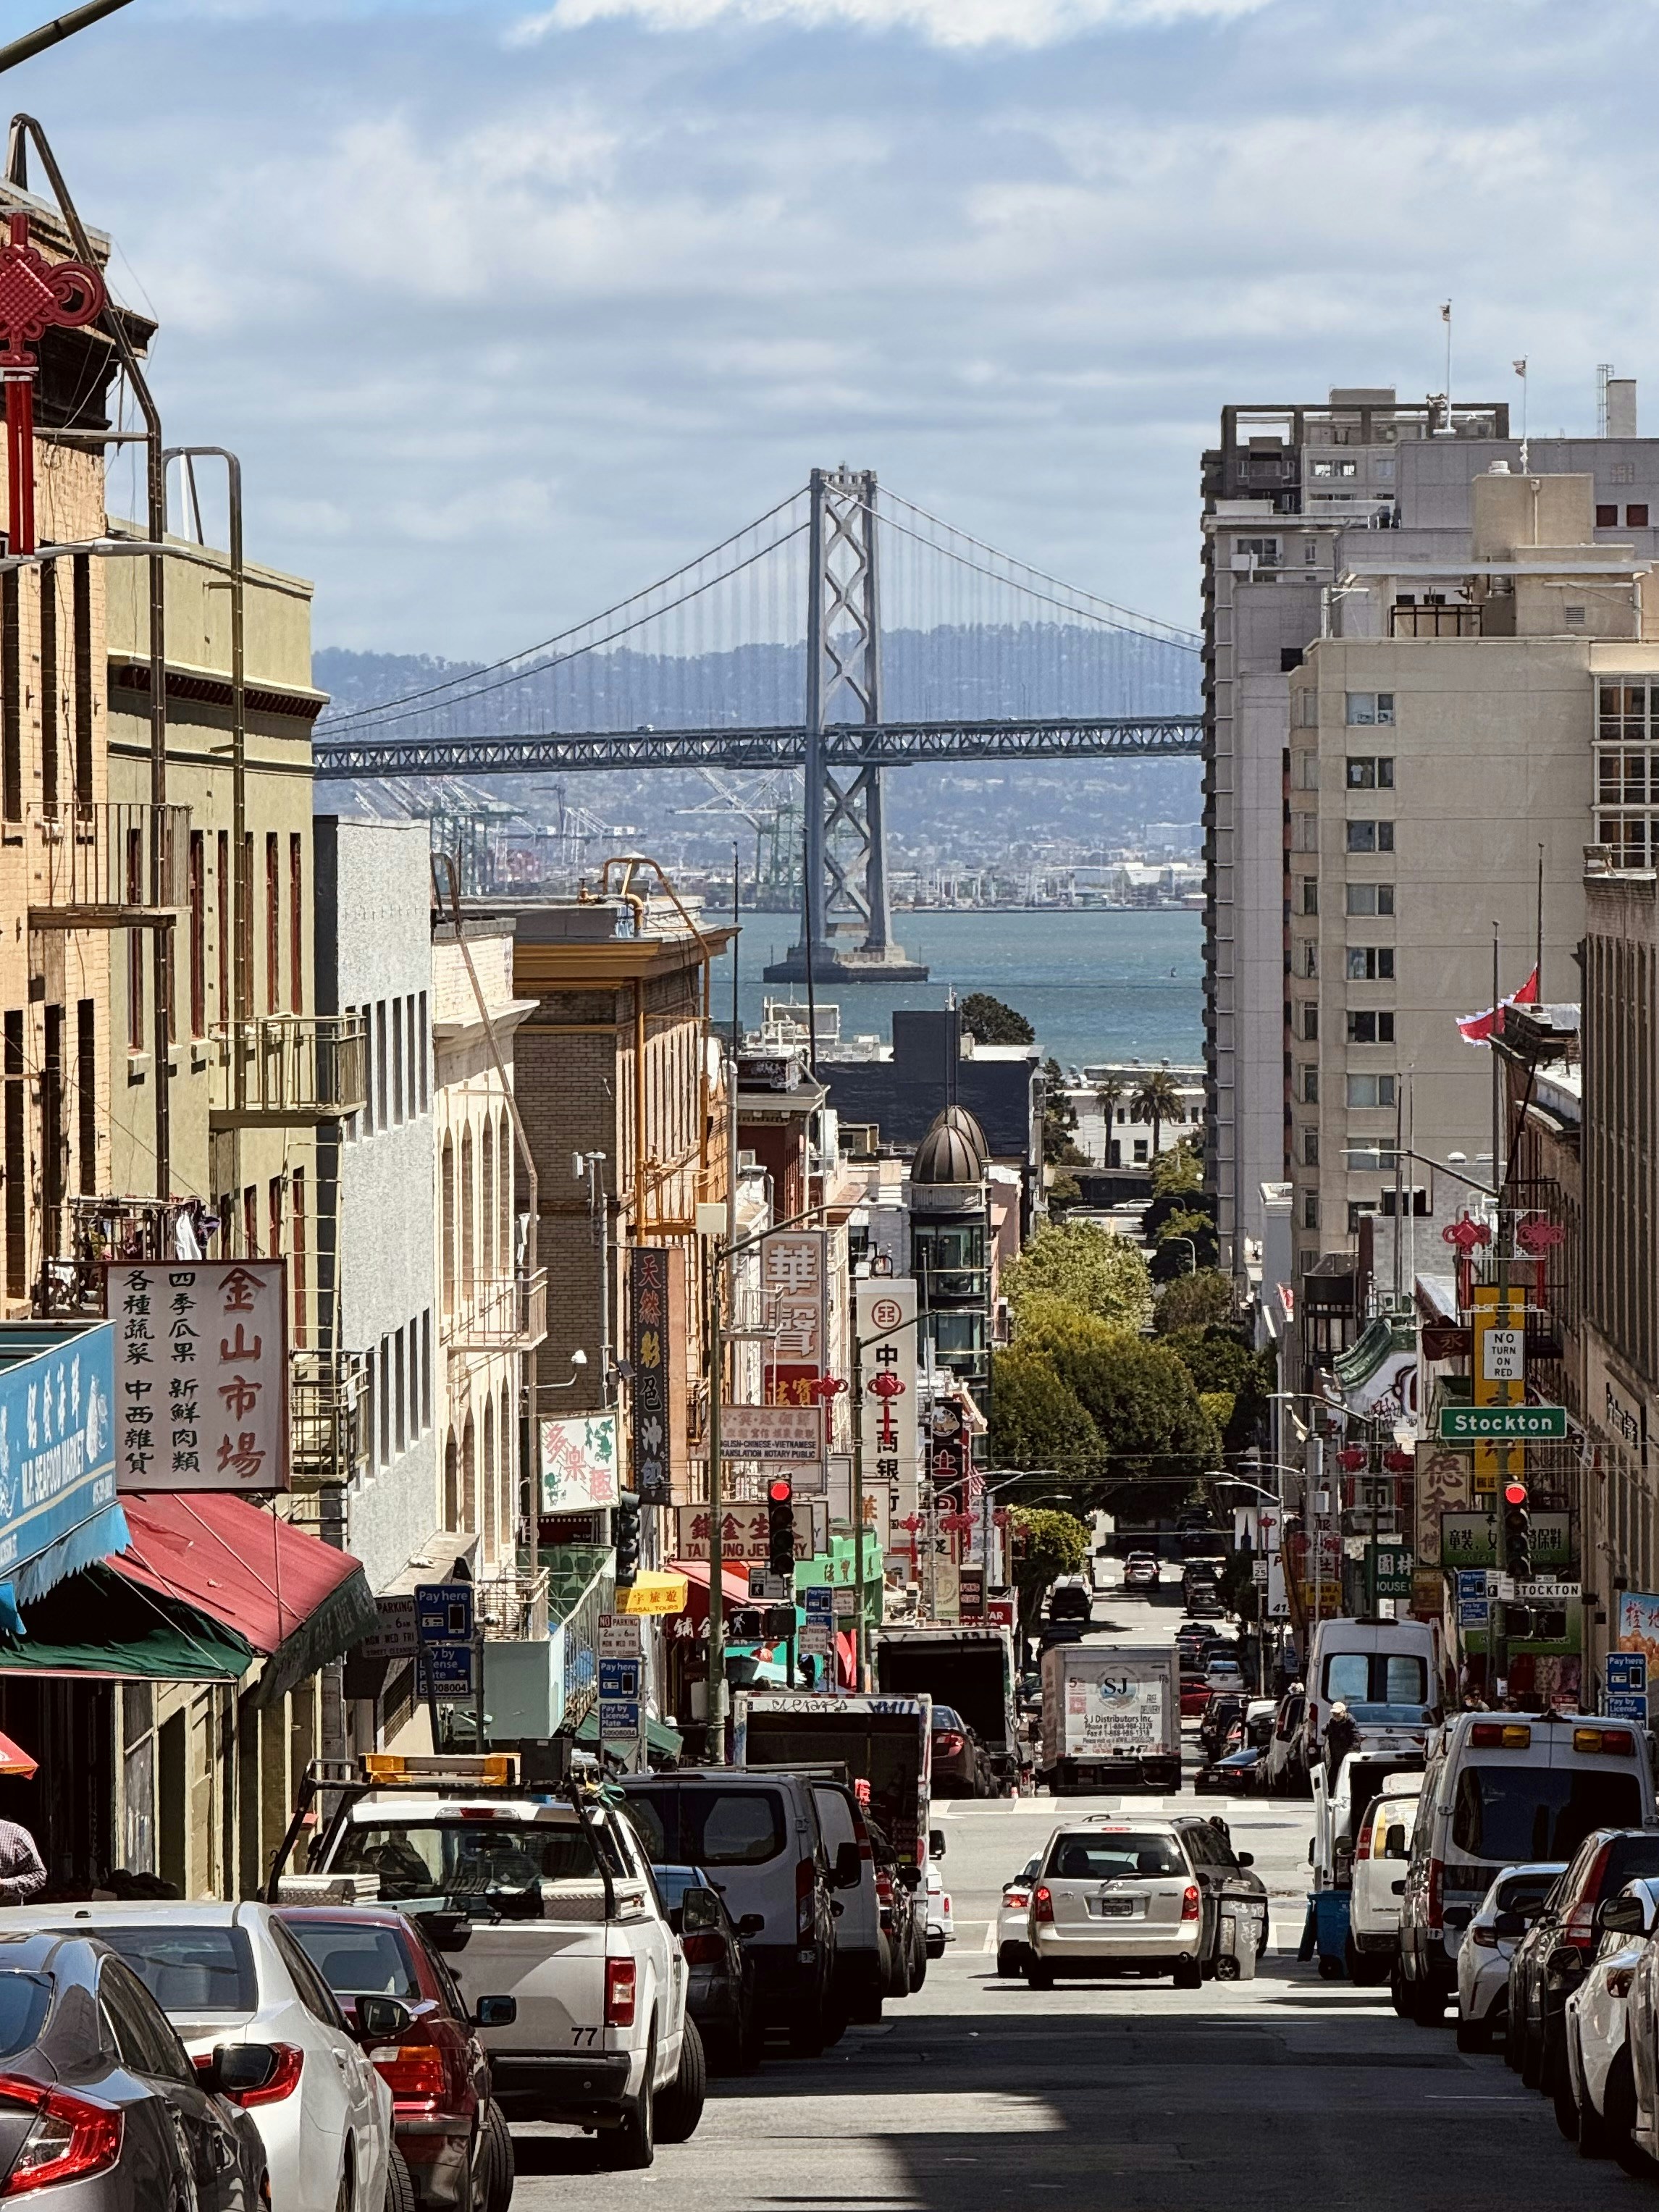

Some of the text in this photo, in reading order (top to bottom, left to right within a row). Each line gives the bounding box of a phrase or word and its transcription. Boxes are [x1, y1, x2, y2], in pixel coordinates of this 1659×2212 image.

[1494, 1333, 1514, 1343] NO
[1492, 1346, 1516, 1355] TURN
[122, 1269, 155, 1475] 各種蔬菜 中西雜貨
[168, 1271, 200, 1473] 四季瓜果 新鮮肉類
[217, 1267, 266, 1479] 金山市場
[1494, 1368, 1513, 1376] RED
[1454, 1415, 1553, 1431] Stockton
[686, 1543, 807, 1557] TAI UNG JEWRY
[419, 1590, 468, 1603] Pay here
[613, 1618, 638, 1627] PARKING
[385, 1634, 398, 1644] WED
[403, 1633, 414, 1641] FRI
[442, 1649, 455, 1659] by
[420, 1660, 458, 1668] Lense
[1609, 1657, 1624, 1667] Pay
[600, 1662, 637, 1673] Pay here
[421, 1683, 466, 1692] 5008004
[1104, 1678, 1128, 1694] SJ
[1609, 1697, 1635, 1707] Pay by
[602, 1704, 627, 1713] Pay by
[571, 2027, 598, 2046] 77
